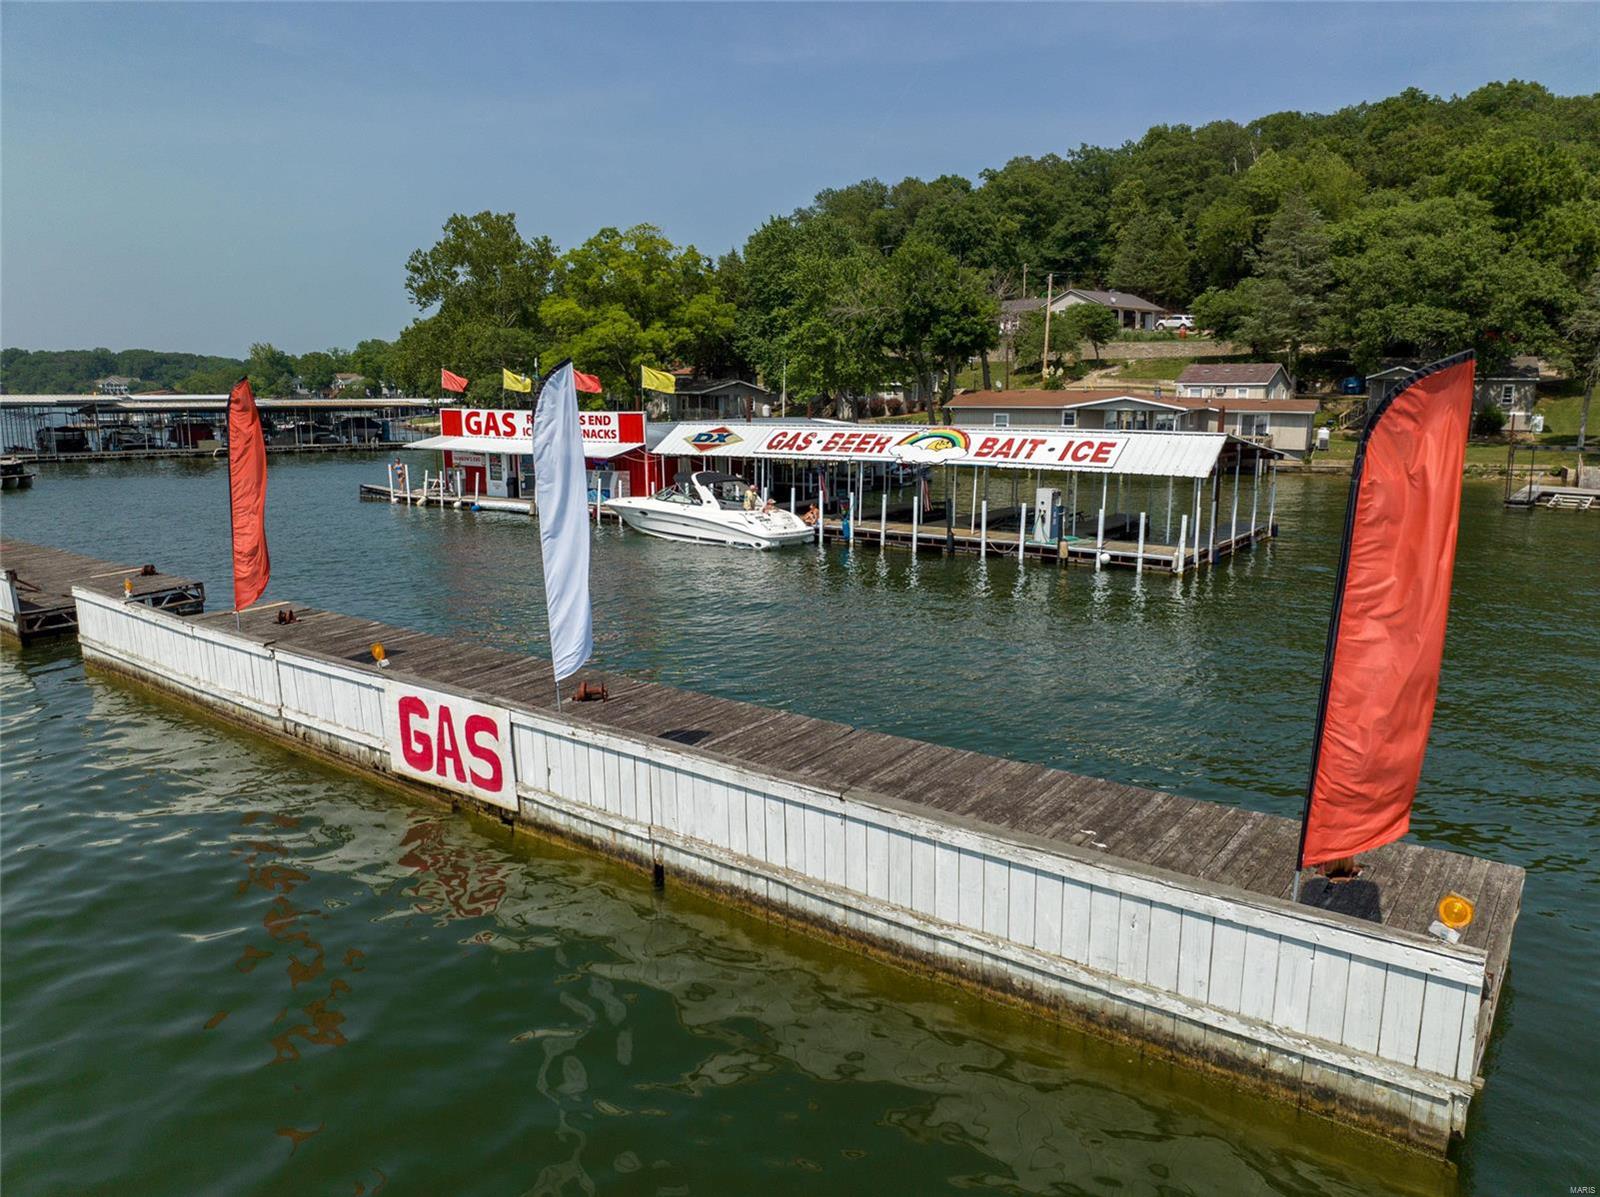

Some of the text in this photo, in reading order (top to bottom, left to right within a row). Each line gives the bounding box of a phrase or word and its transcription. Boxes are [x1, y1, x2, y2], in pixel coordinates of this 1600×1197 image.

[465, 411, 516, 437] GAS
[588, 415, 611, 426] END
[580, 429, 617, 439] NACKS
[691, 432, 733, 443] DX
[974, 436, 1047, 460] BAIT
[1058, 440, 1117, 463] ICE
[398, 696, 503, 792] GAS
